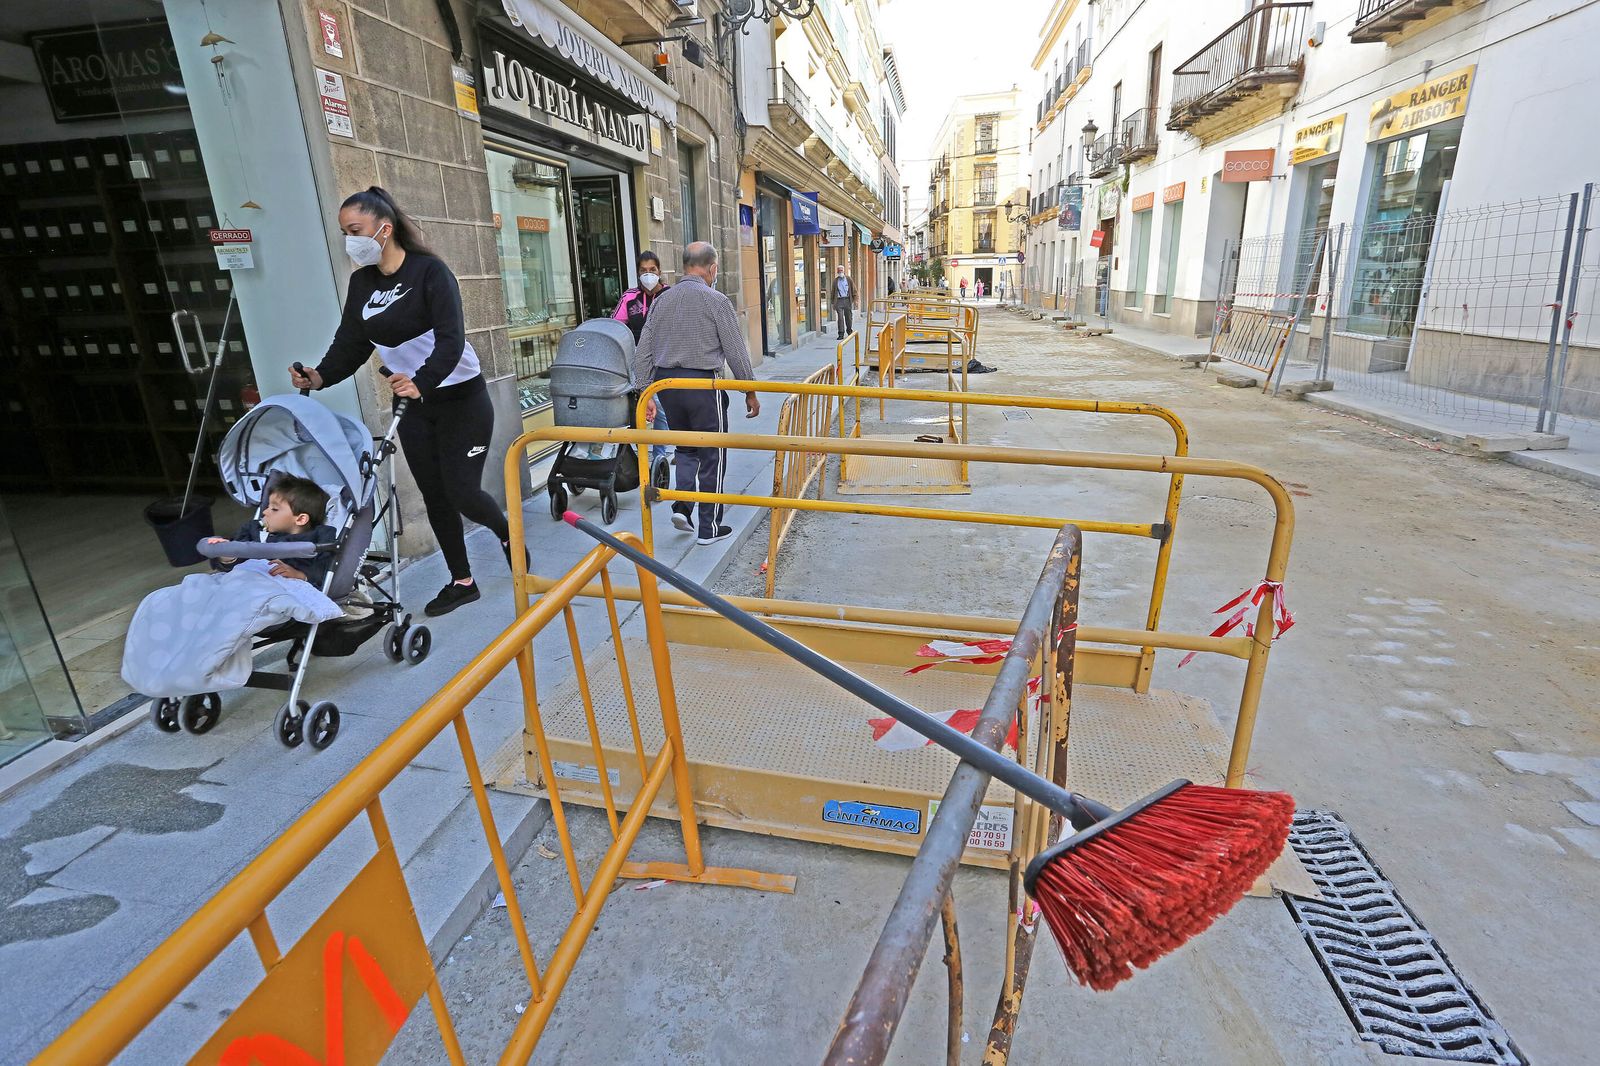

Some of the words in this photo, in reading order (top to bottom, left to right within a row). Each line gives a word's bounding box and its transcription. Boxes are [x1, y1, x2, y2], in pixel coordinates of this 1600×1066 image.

[52, 49, 160, 85] AROMAS
[556, 20, 615, 81] JOYERIA
[619, 64, 654, 106] NANDO
[491, 51, 594, 131] JOYERÍA
[593, 102, 646, 152] NANDO
[1408, 73, 1468, 108] RANGER
[1400, 96, 1461, 129] AIRSOFT
[1296, 120, 1334, 143] RANGER
[1225, 160, 1270, 171] GOCCO
[212, 232, 249, 240] CERRADO
[370, 283, 402, 304] NIKE
[353, 547, 369, 578] asalvo
[969, 838, 981, 846] 00
[983, 839, 993, 847] 16
[994, 840, 1006, 848] 59
[970, 830, 982, 838] 30
[983, 831, 995, 839] 70
